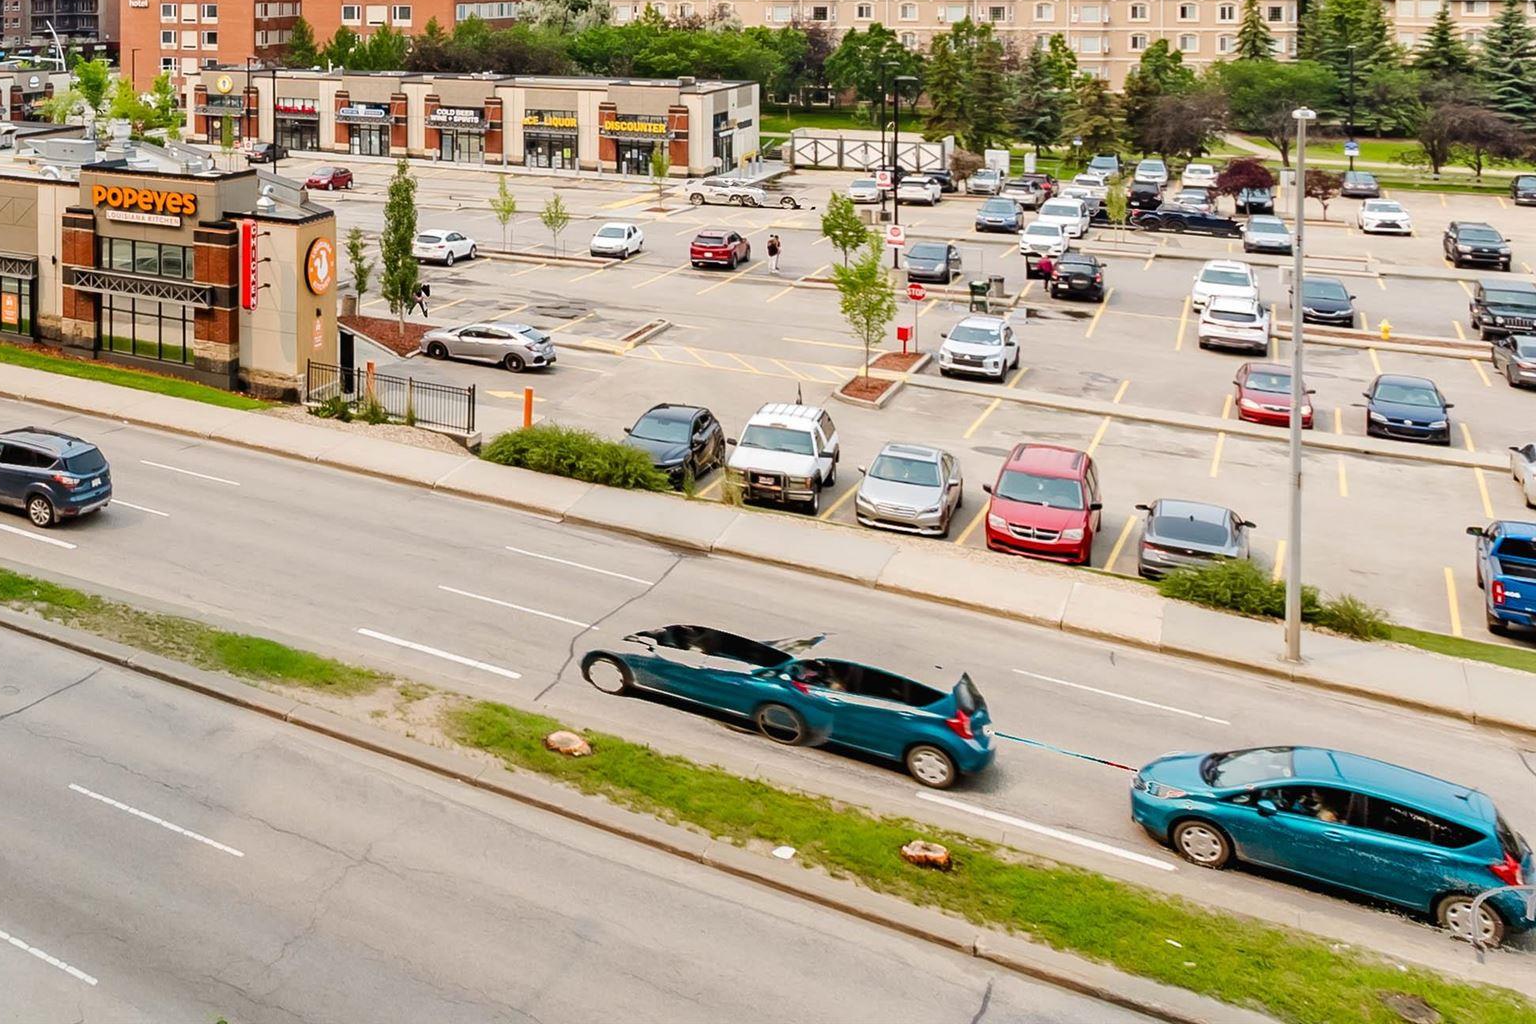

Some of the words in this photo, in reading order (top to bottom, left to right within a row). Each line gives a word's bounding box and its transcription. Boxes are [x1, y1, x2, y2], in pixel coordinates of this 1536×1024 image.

[543, 116, 577, 128] LIQUOR
[604, 120, 667, 134] DISCOUNTER
[107, 211, 146, 221] LOUISIANA
[907, 287, 926, 297] STOP
